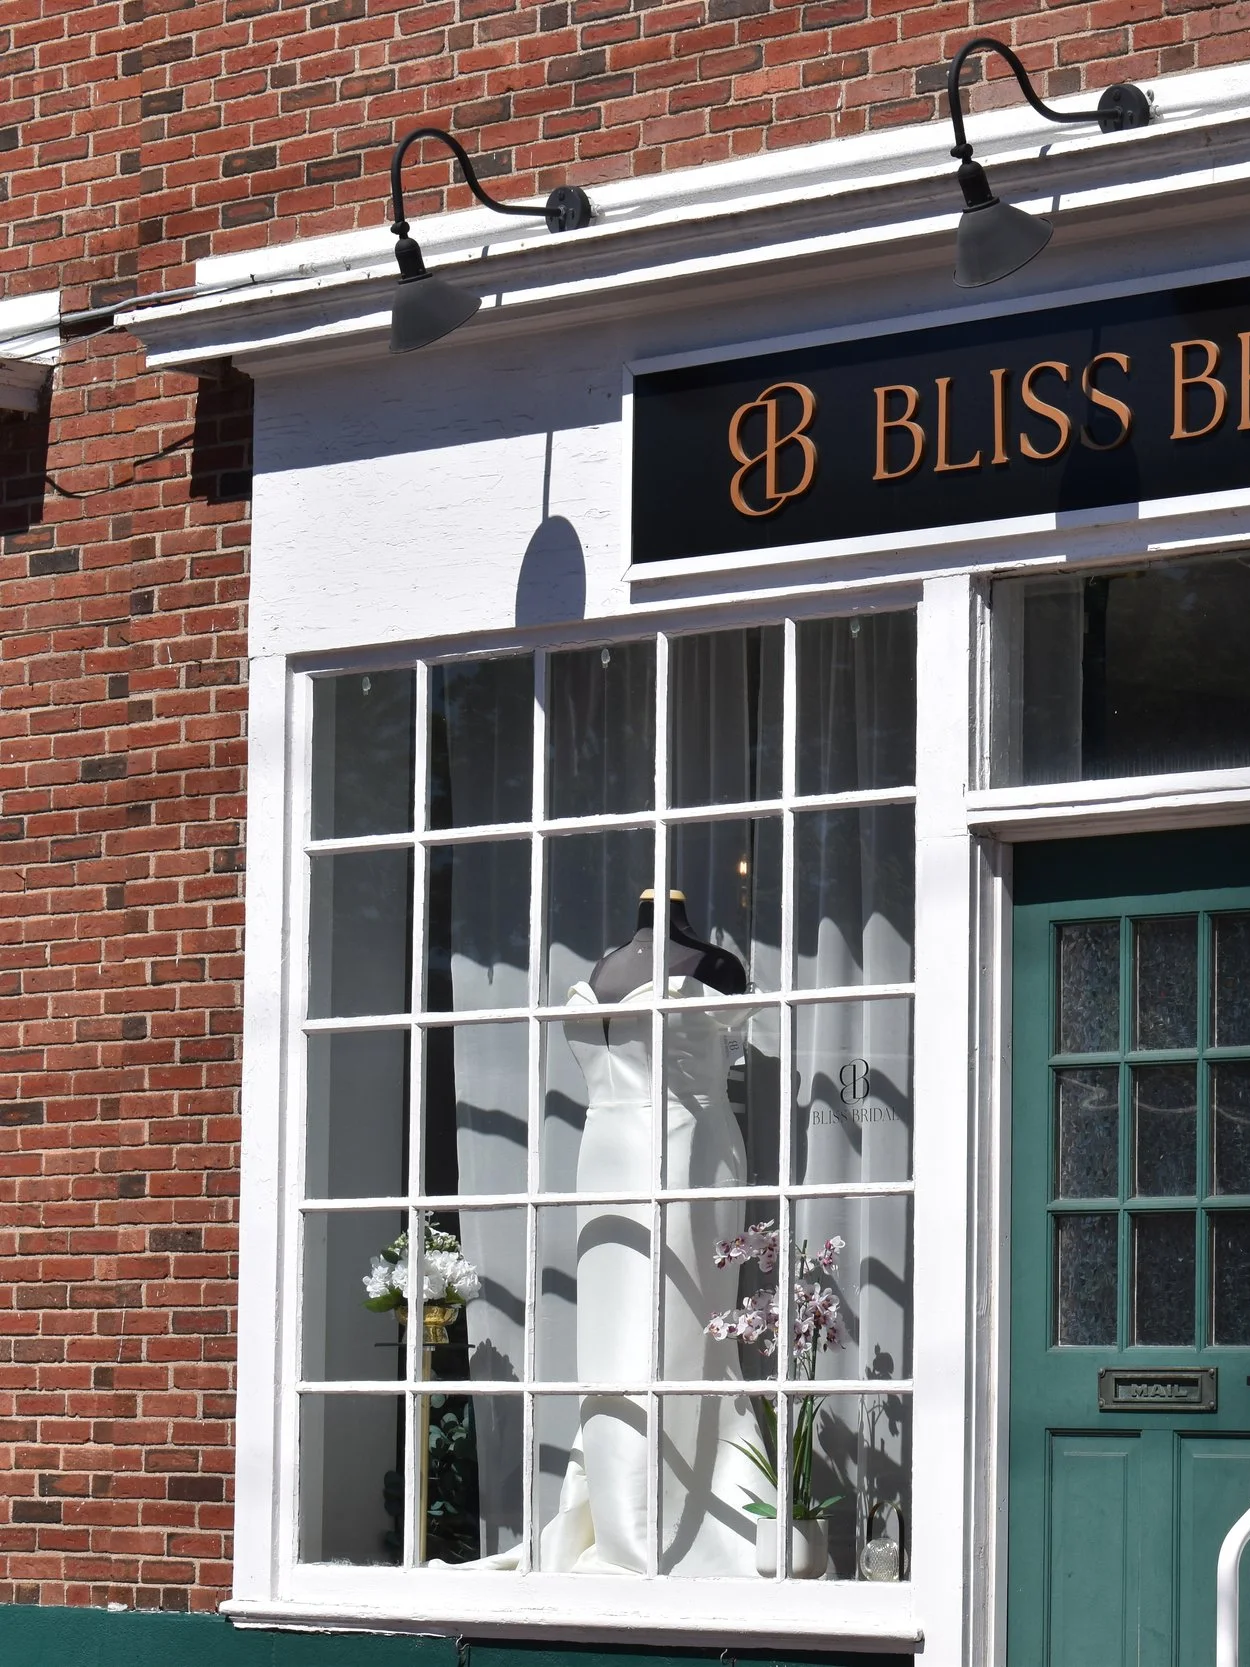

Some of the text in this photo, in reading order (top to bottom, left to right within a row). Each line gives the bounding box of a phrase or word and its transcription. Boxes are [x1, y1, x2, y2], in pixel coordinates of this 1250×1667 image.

[872, 351, 1134, 481] BLISS
[813, 1106, 900, 1125] BLISS BRIDAL
[1131, 1383, 1188, 1398] MAIL
